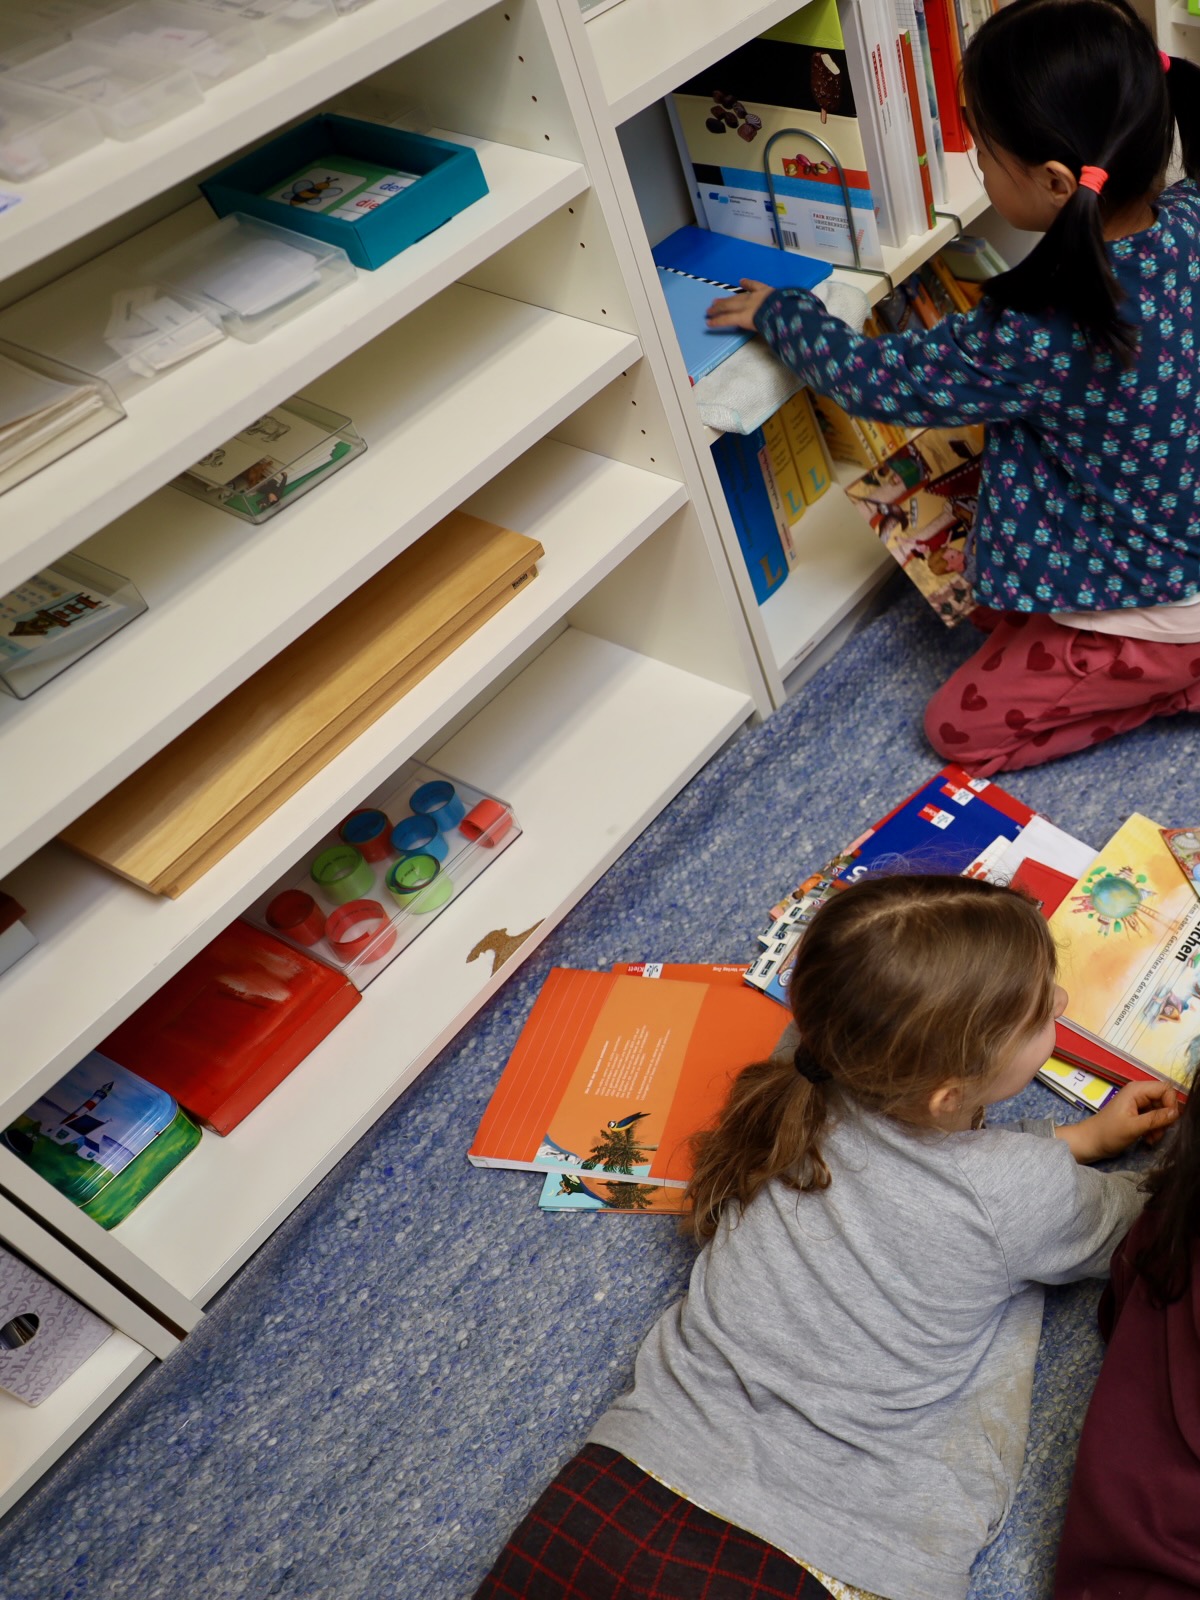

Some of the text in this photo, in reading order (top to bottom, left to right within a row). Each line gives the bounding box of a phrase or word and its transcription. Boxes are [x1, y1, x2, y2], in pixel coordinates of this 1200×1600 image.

[378, 181, 406, 191] der
[355, 199, 379, 209] die
[813, 218, 850, 229] URHEBERRECH
[825, 215, 849, 223] KOPIERE
[808, 467, 825, 492] L
[784, 490, 803, 517] L
[759, 549, 783, 589] L
[845, 863, 868, 883] 5
[1188, 903, 1199, 915] dem
[1176, 914, 1192, 931] Leben
[1150, 935, 1177, 969] Geschichten
[1143, 969, 1153, 981] aus
[1135, 980, 1147, 993] den
[1114, 992, 1142, 1026] Religionen
